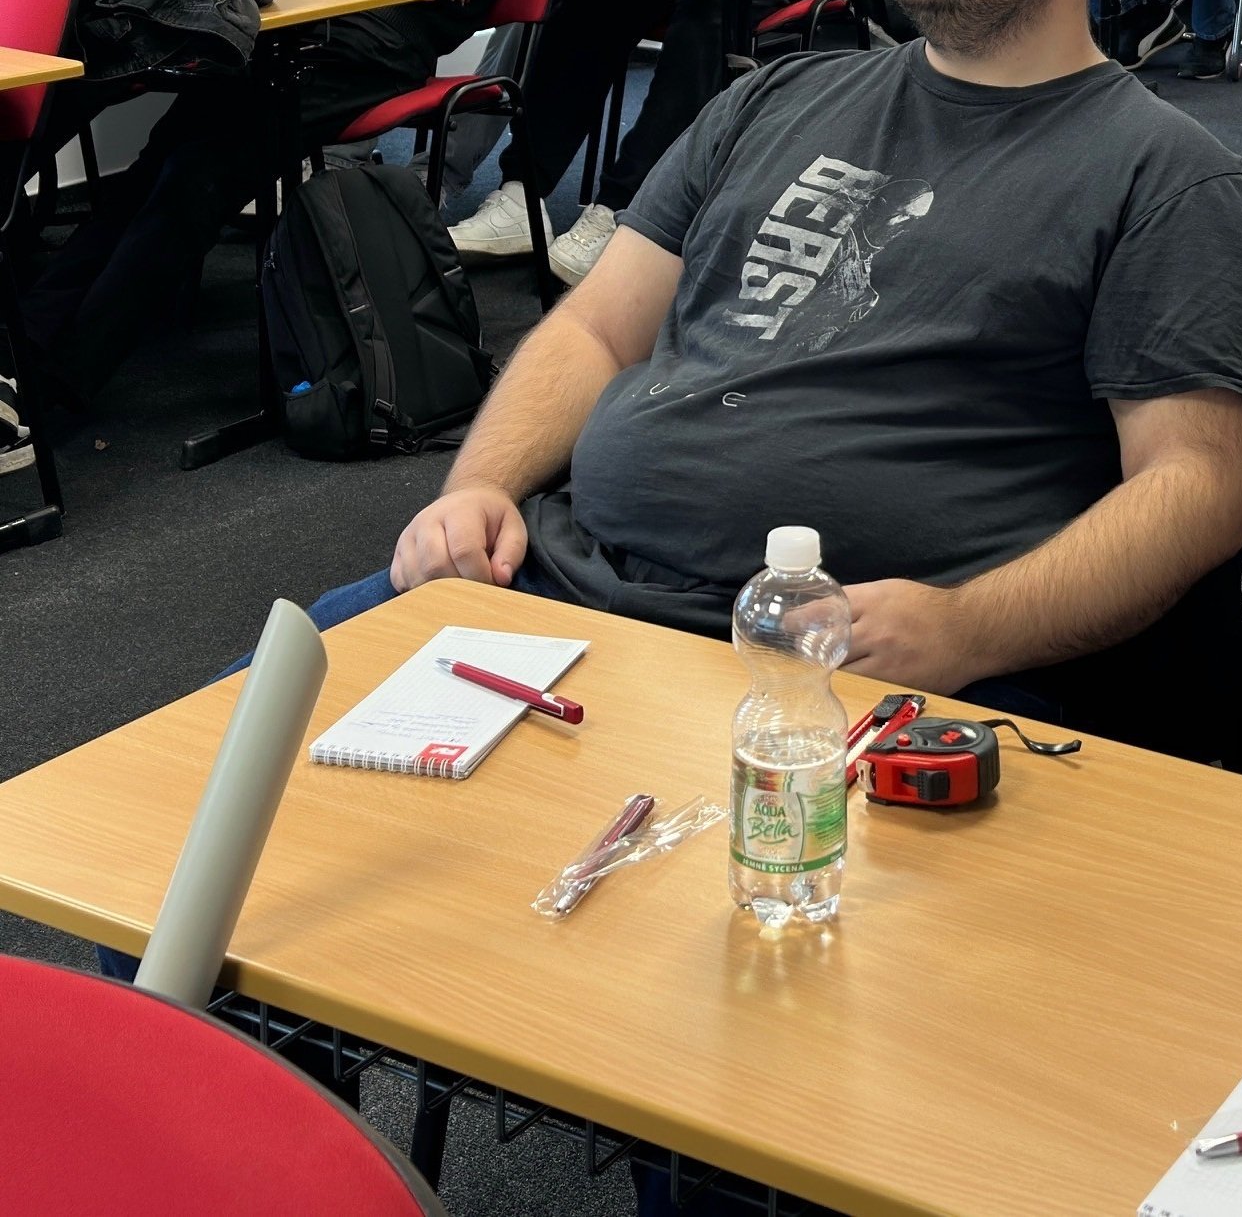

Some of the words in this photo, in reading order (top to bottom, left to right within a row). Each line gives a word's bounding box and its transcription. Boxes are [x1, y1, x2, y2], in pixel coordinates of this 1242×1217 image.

[722, 154, 894, 341] BEAST
[754, 803, 786, 817] AQUA
[746, 816, 800, 839] Bella
